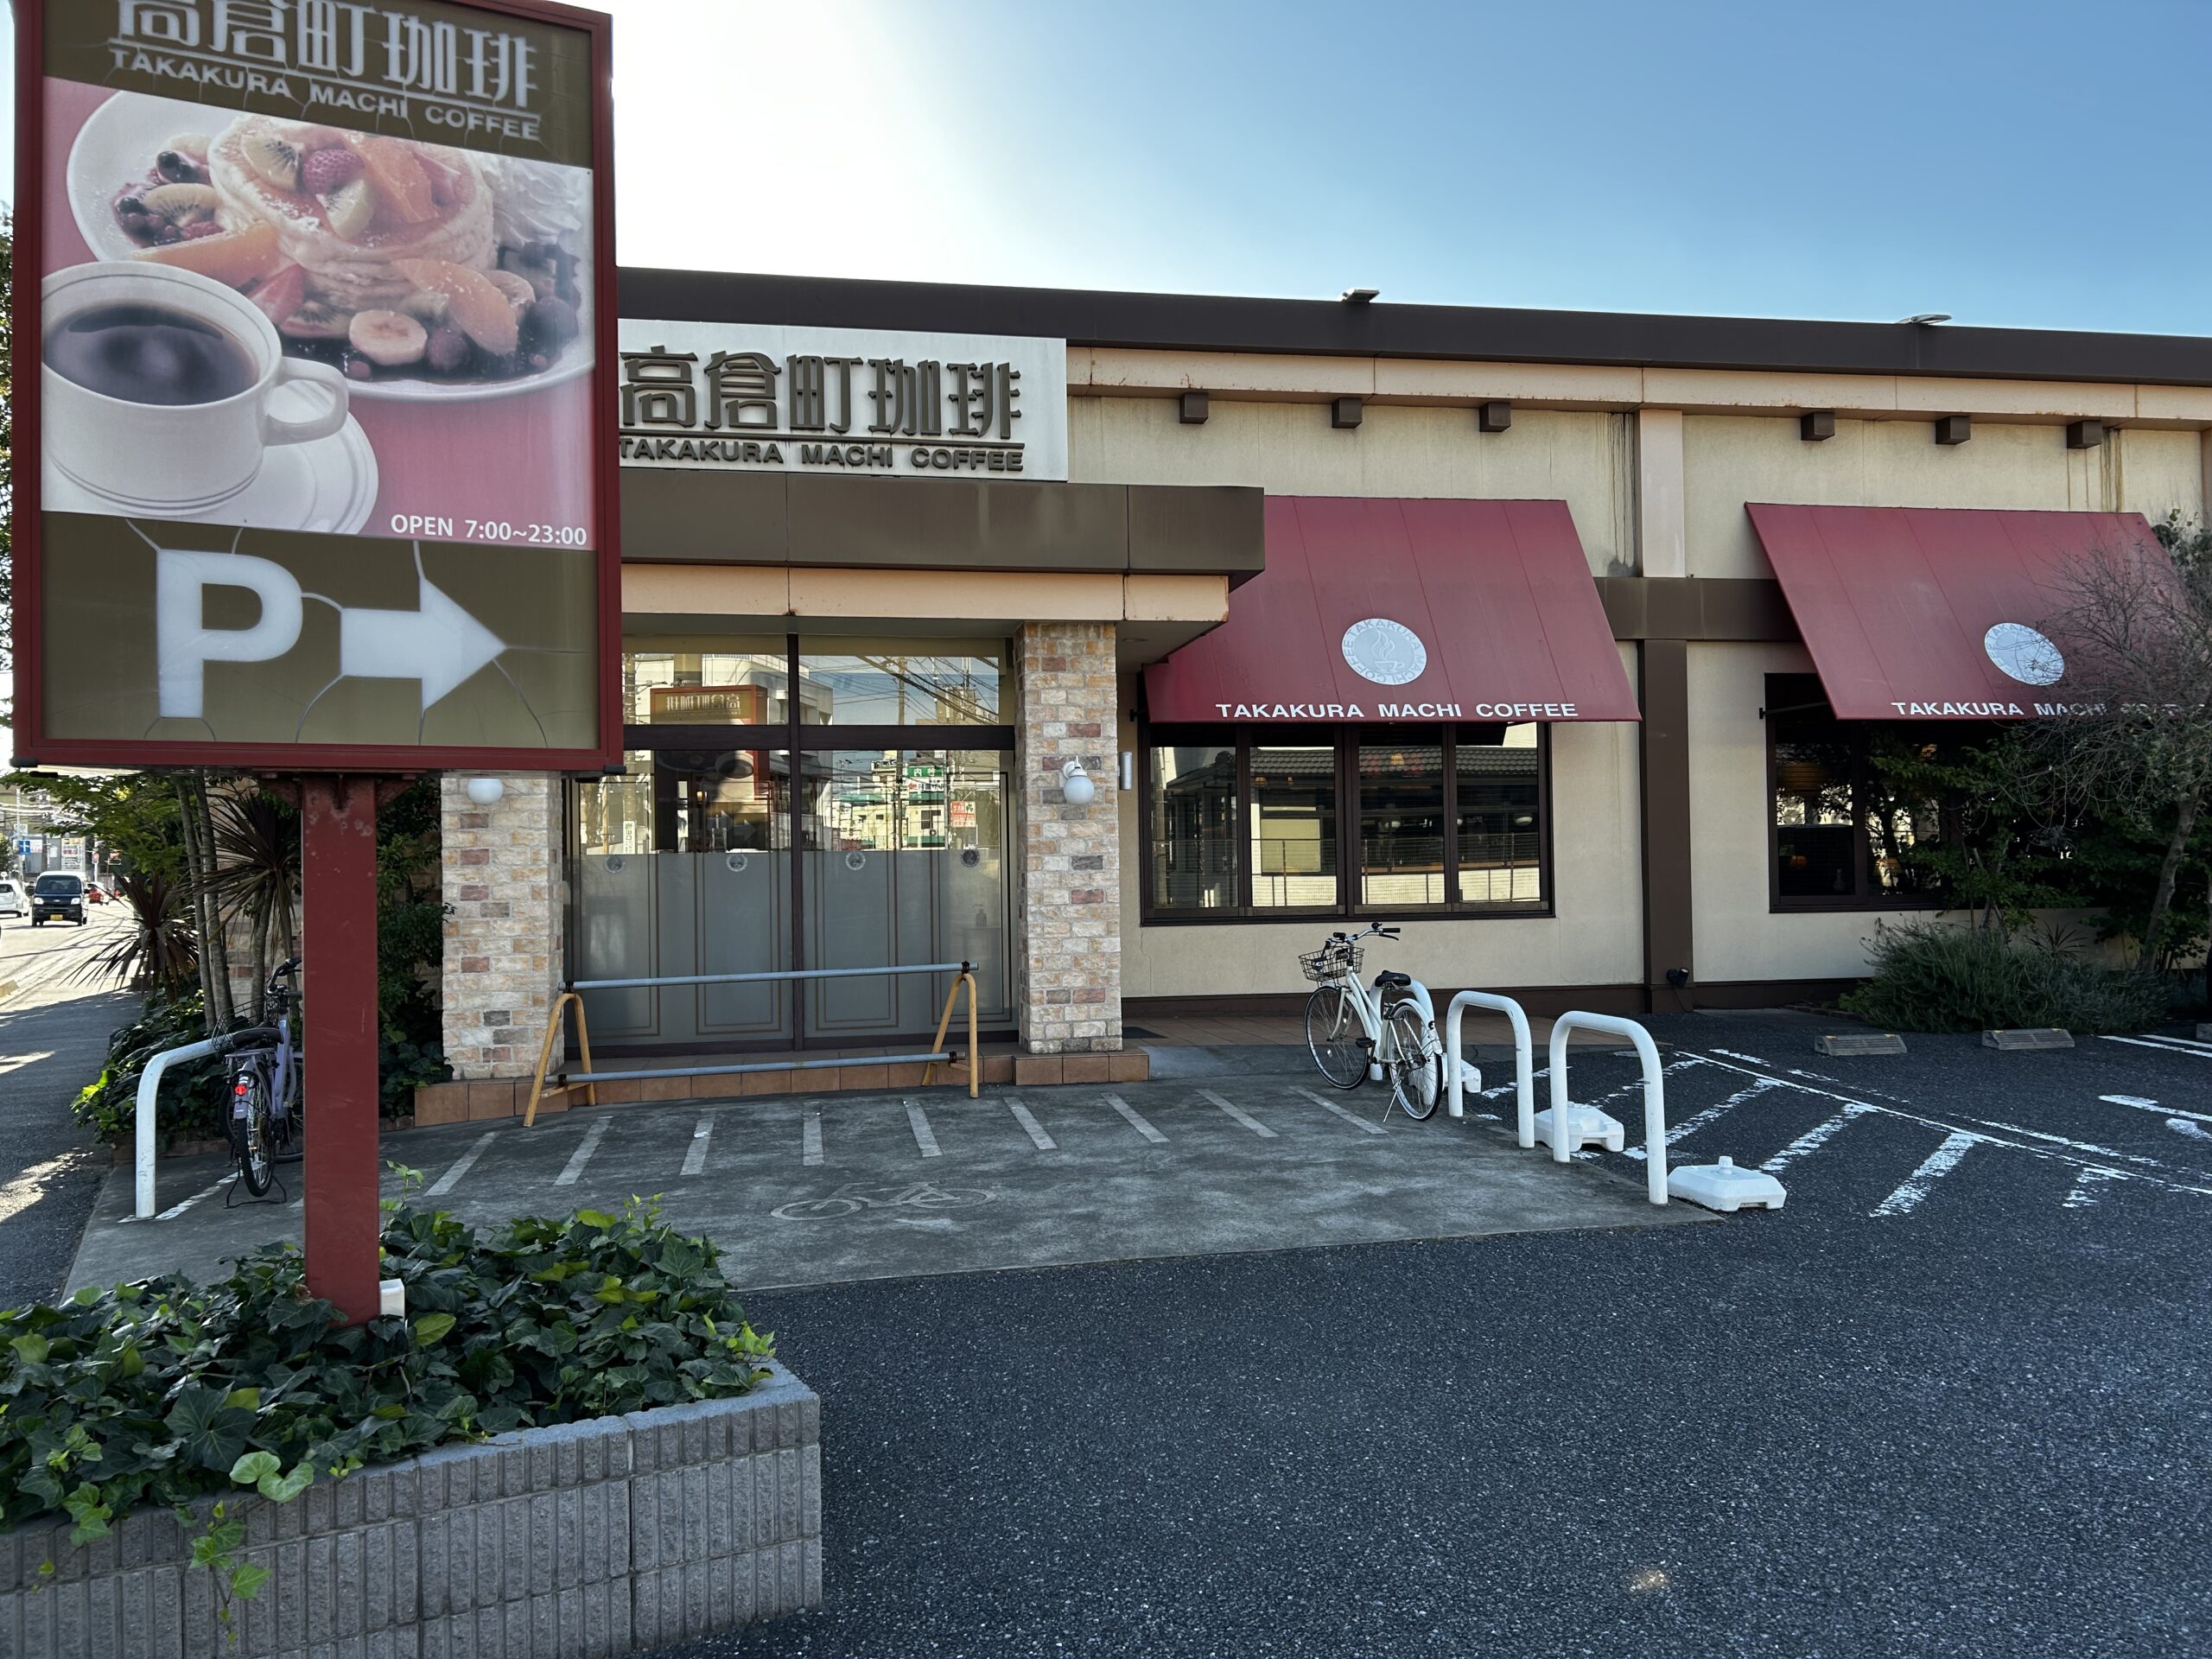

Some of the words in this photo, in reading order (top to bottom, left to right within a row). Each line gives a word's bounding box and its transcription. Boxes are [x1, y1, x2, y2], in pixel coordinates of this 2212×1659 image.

[108, 48, 291, 98] TAKAKURA
[308, 84, 409, 118] MACHI
[424, 106, 541, 141] COFFEE
[620, 345, 1022, 440] 高倉町珈琲
[620, 437, 784, 464] TAKAKURA
[801, 444, 893, 467] MACHI
[911, 448, 1024, 472] COFFEE
[391, 514, 454, 537] OPEN
[156, 549, 303, 719] P
[1344, 620, 1421, 651] TAKAKURA
[1343, 639, 1387, 683] COFFEE
[1216, 703, 1365, 718] TAKAKURA
[1377, 703, 1462, 718] MACHI
[1475, 702, 1580, 718] COFFEE
[1891, 702, 2024, 716] TAKAKURA
